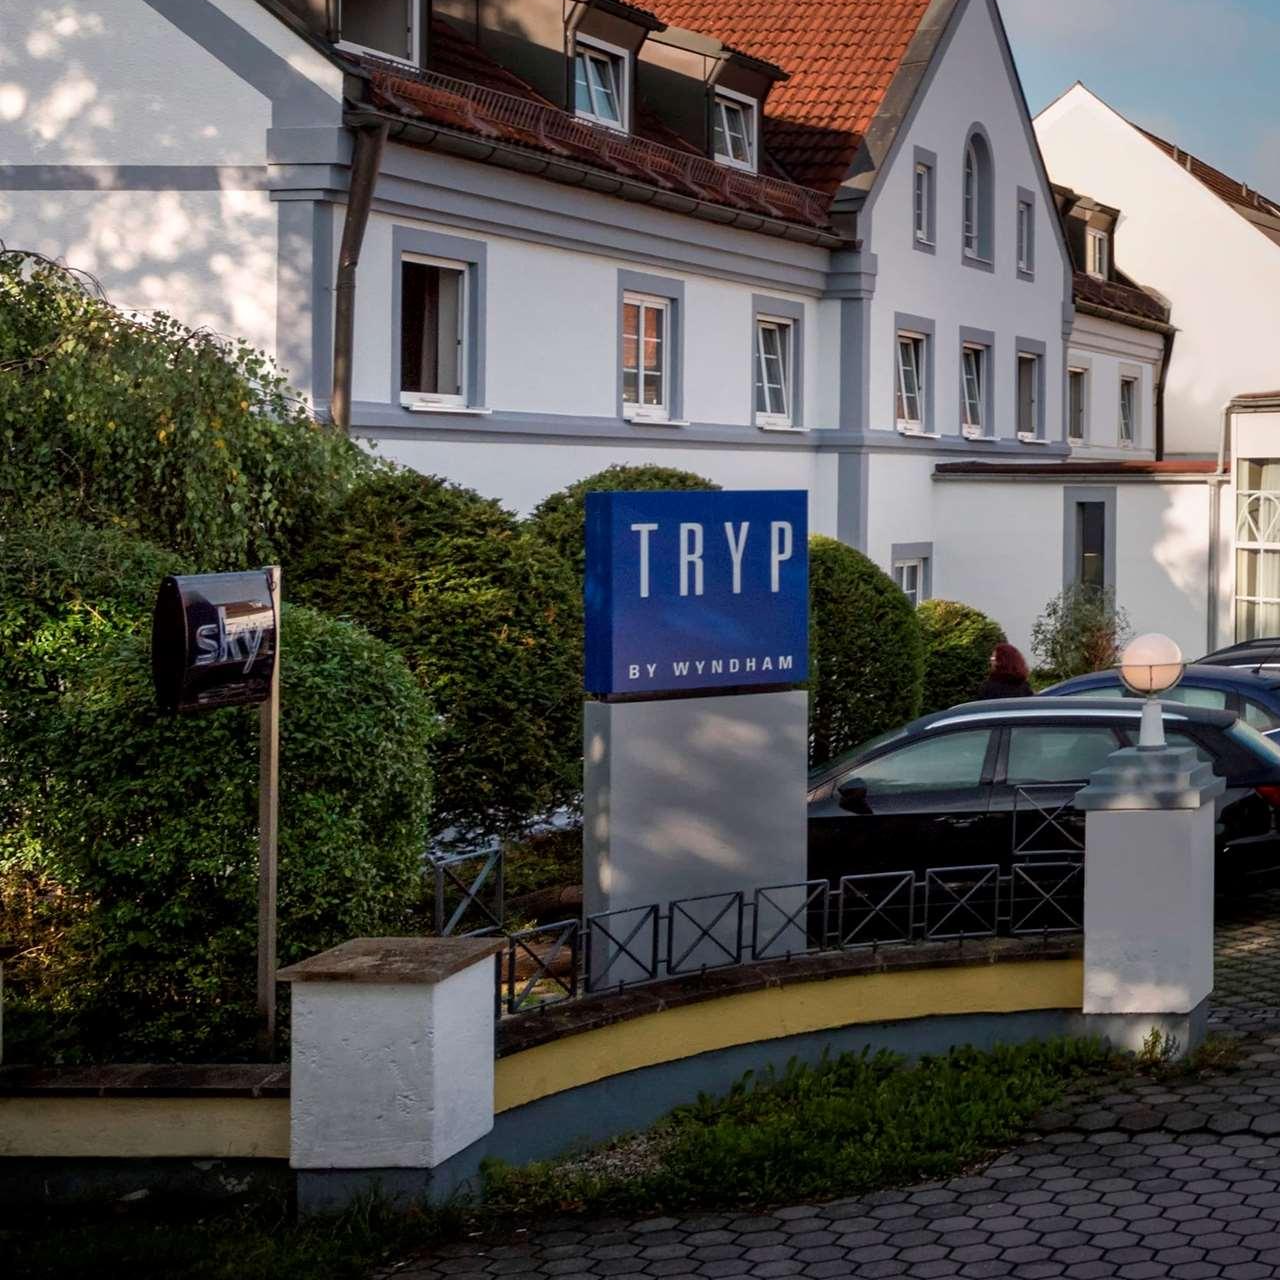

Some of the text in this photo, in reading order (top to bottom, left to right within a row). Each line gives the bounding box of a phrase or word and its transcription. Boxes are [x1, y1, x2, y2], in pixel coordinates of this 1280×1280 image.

[631, 521, 793, 598] TRYP
[195, 606, 264, 674] sky
[629, 655, 793, 679] BY WYNDHAM
